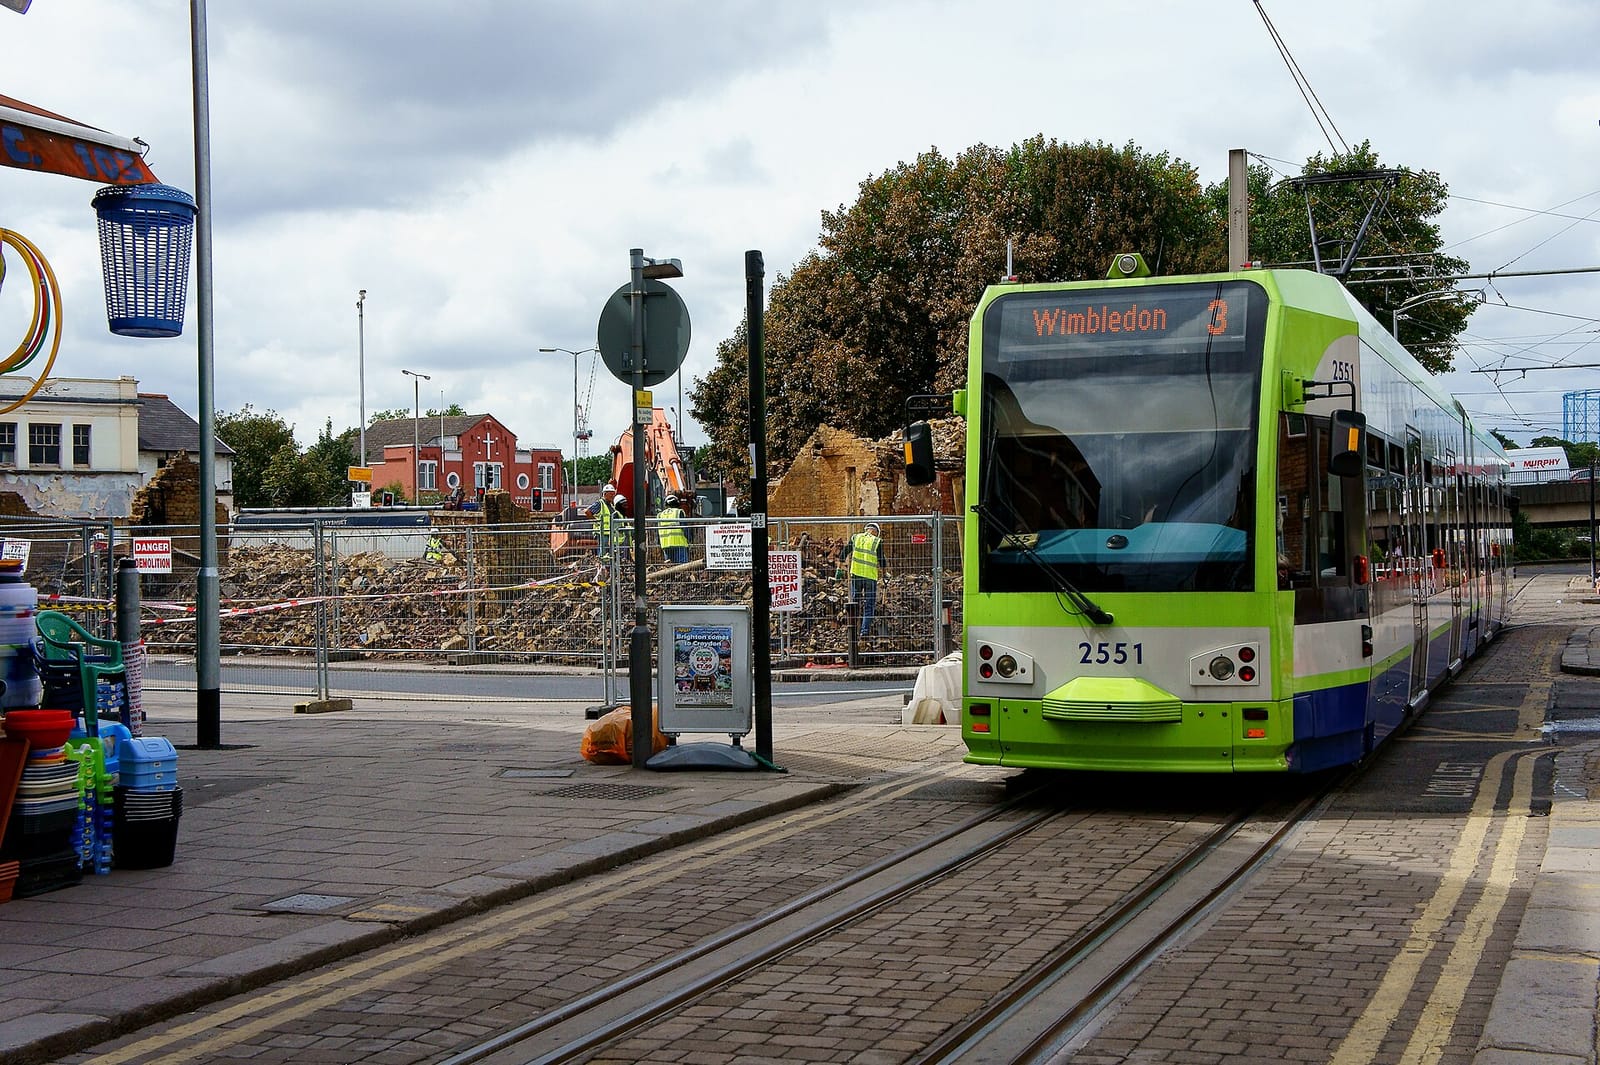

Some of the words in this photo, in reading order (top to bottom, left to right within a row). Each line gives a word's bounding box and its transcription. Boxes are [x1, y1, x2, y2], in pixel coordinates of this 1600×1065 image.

[1031, 304, 1167, 337] Wimbledon
[1207, 299, 1229, 335] 3
[1332, 359, 1354, 382] 2551
[1523, 458, 1561, 468] MURPHY
[721, 535, 744, 544] 777
[135, 543, 169, 551] DANGER
[135, 558, 171, 568] DEMOLITION
[768, 555, 798, 563] REEVES
[769, 583, 798, 595] OPEN
[772, 598, 798, 608] USINESS
[1078, 642, 1143, 665] 2551
